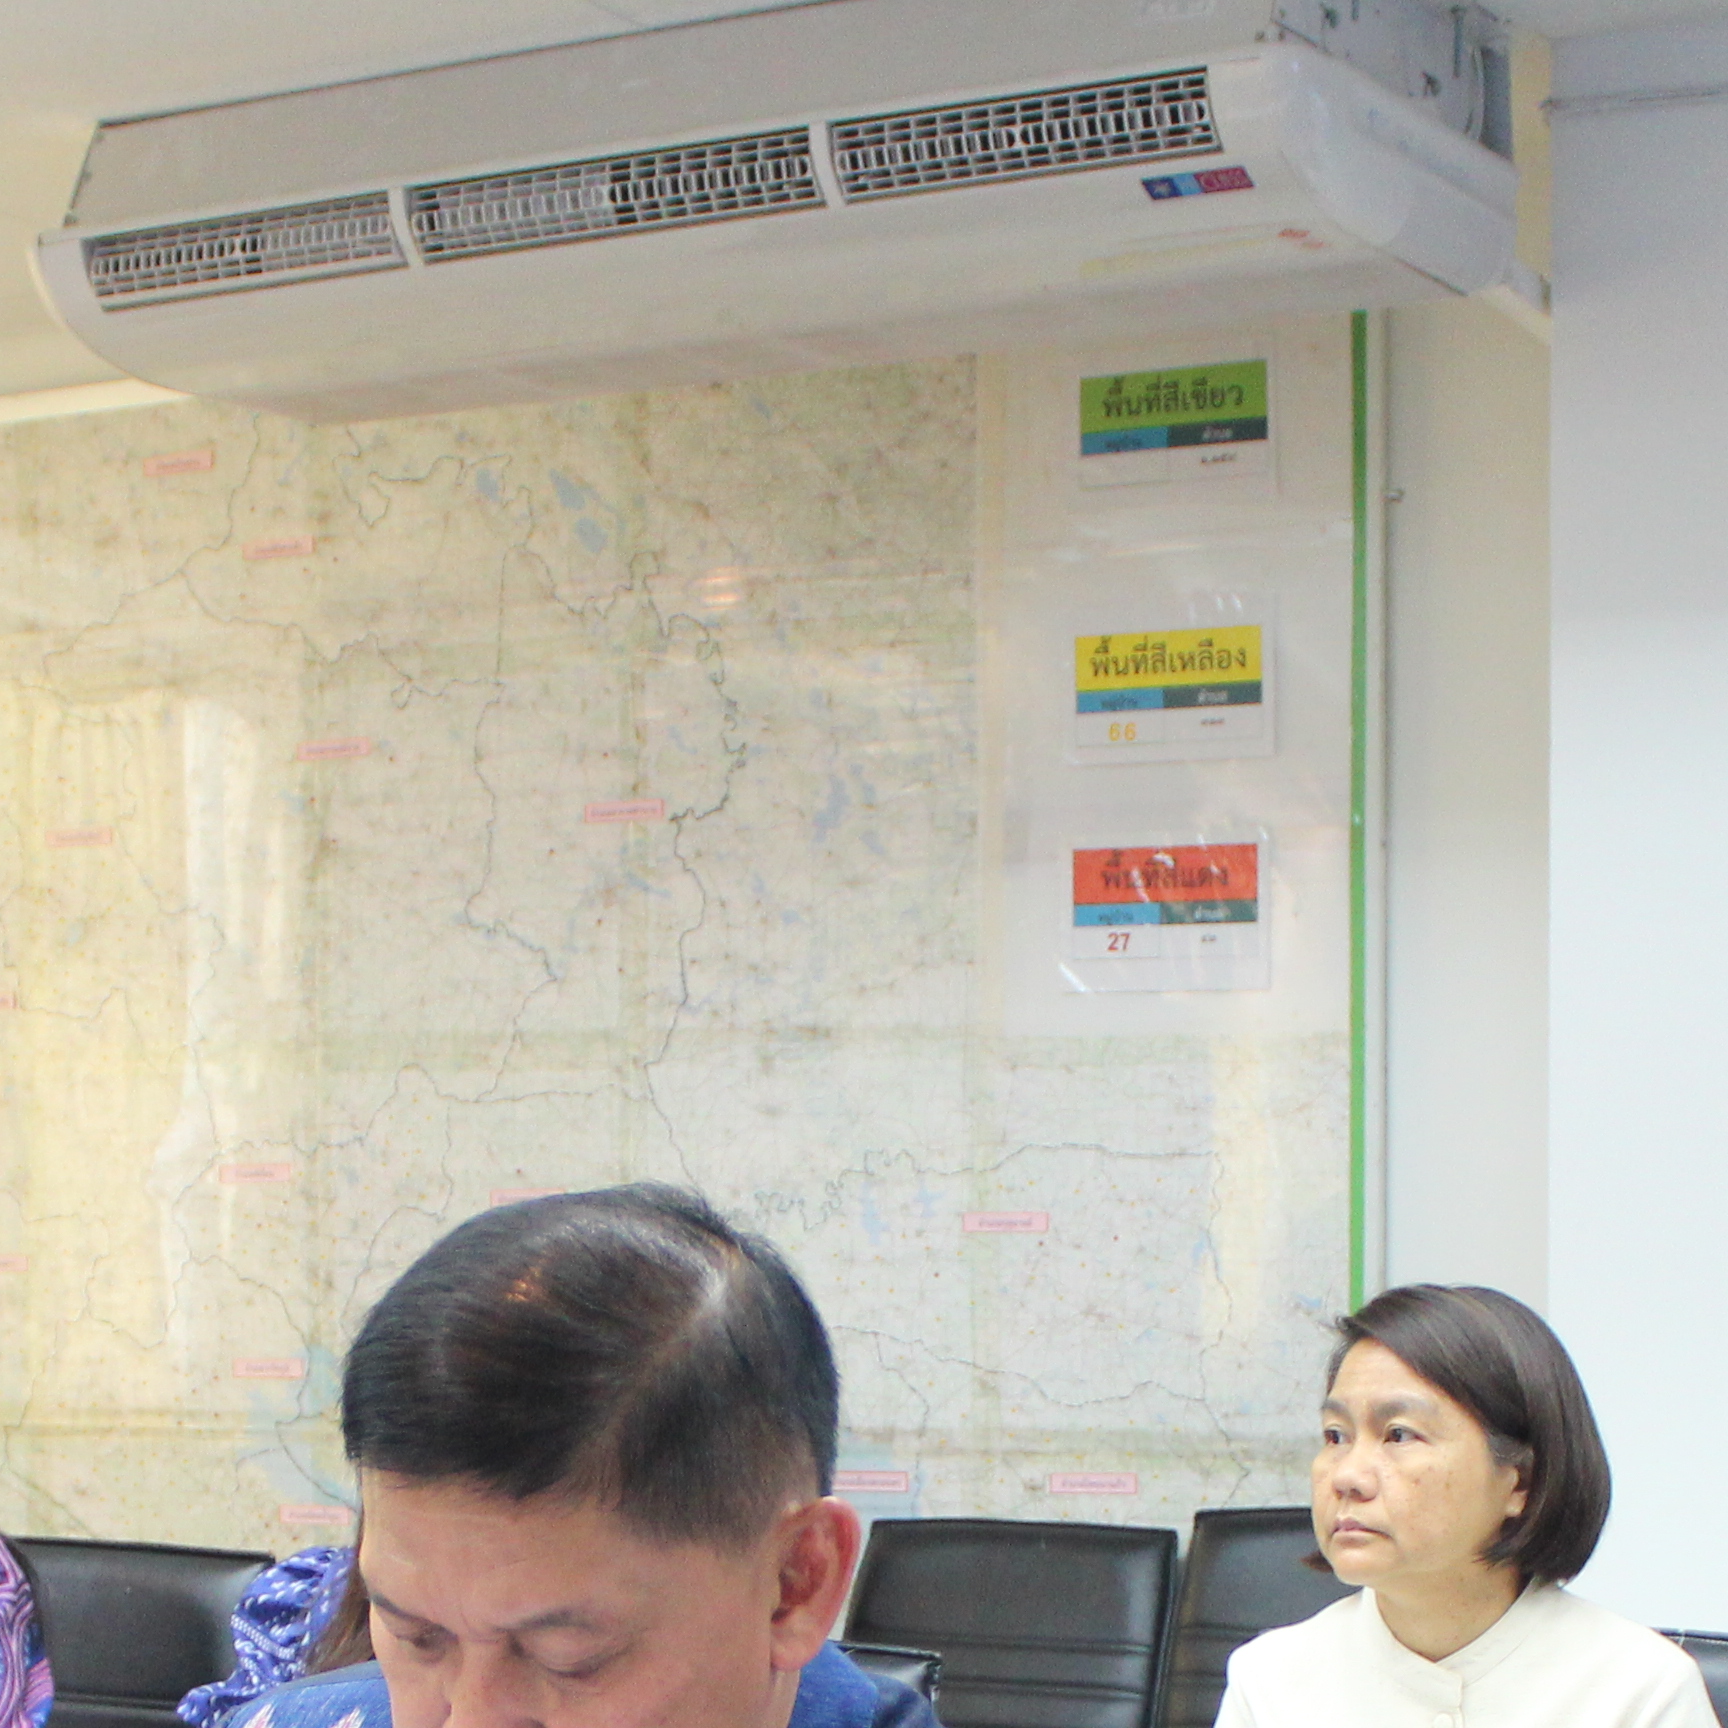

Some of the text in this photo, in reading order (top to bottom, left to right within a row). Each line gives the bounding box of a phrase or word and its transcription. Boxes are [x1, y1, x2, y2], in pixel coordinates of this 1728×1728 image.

[1089, 635, 1248, 677] พื้นที่สีเหลือง
[1107, 722, 1138, 742] 66
[1106, 932, 1132, 951] 27
